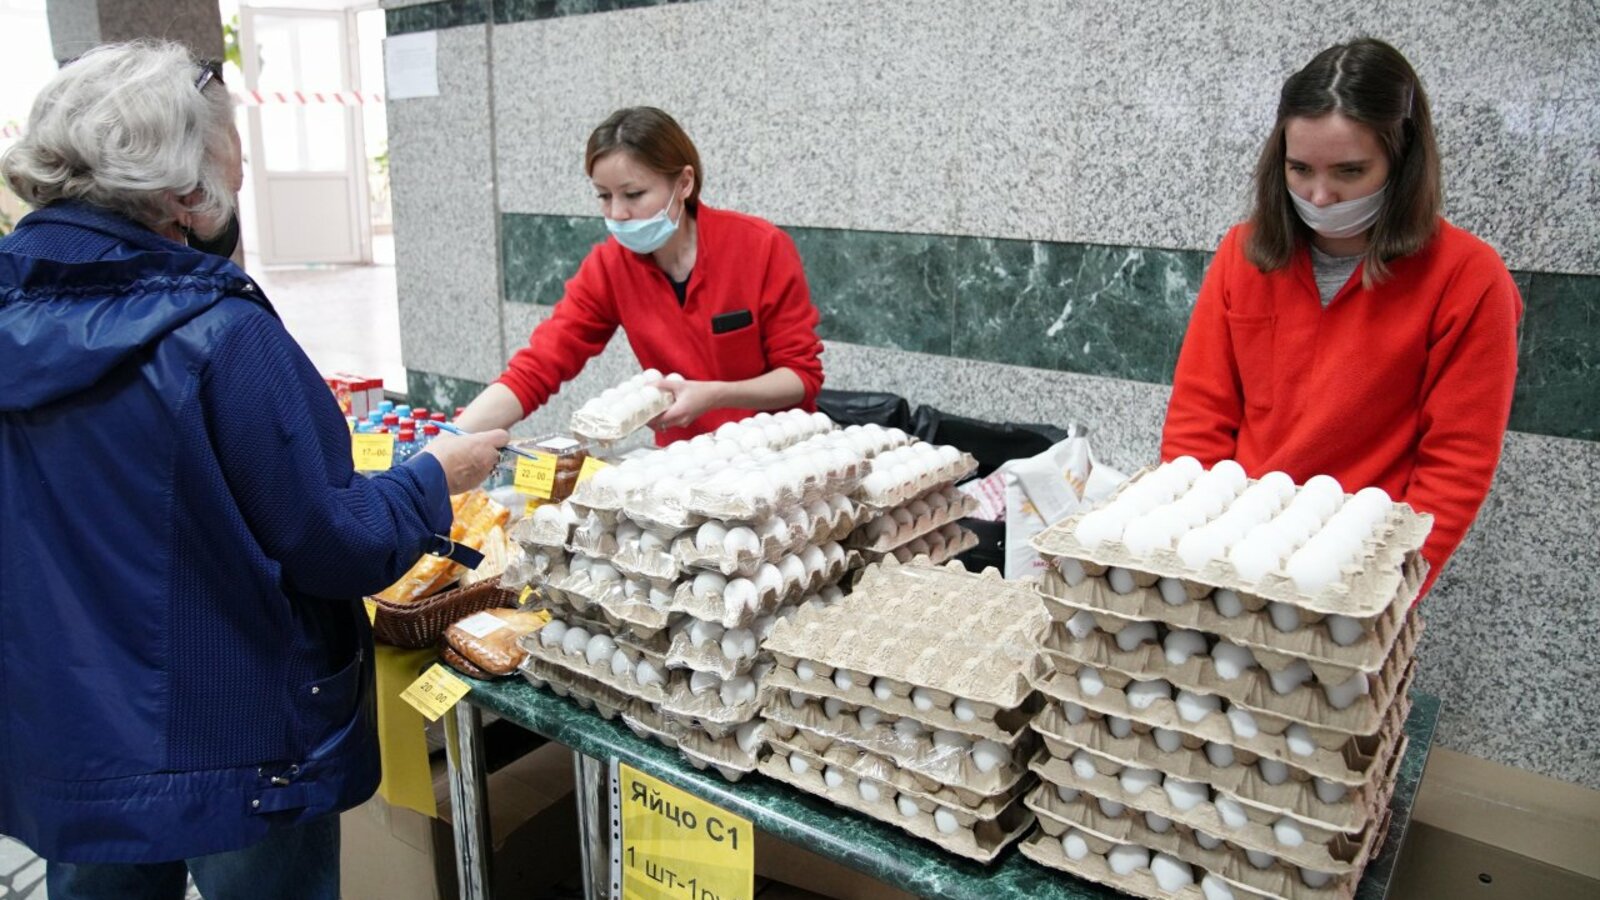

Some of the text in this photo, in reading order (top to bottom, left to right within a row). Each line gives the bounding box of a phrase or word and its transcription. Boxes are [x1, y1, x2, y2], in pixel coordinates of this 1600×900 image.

[420, 681, 433, 693] 20
[435, 692, 448, 704] 00
[631, 780, 738, 851] Яйцо С1
[626, 845, 636, 868] 1
